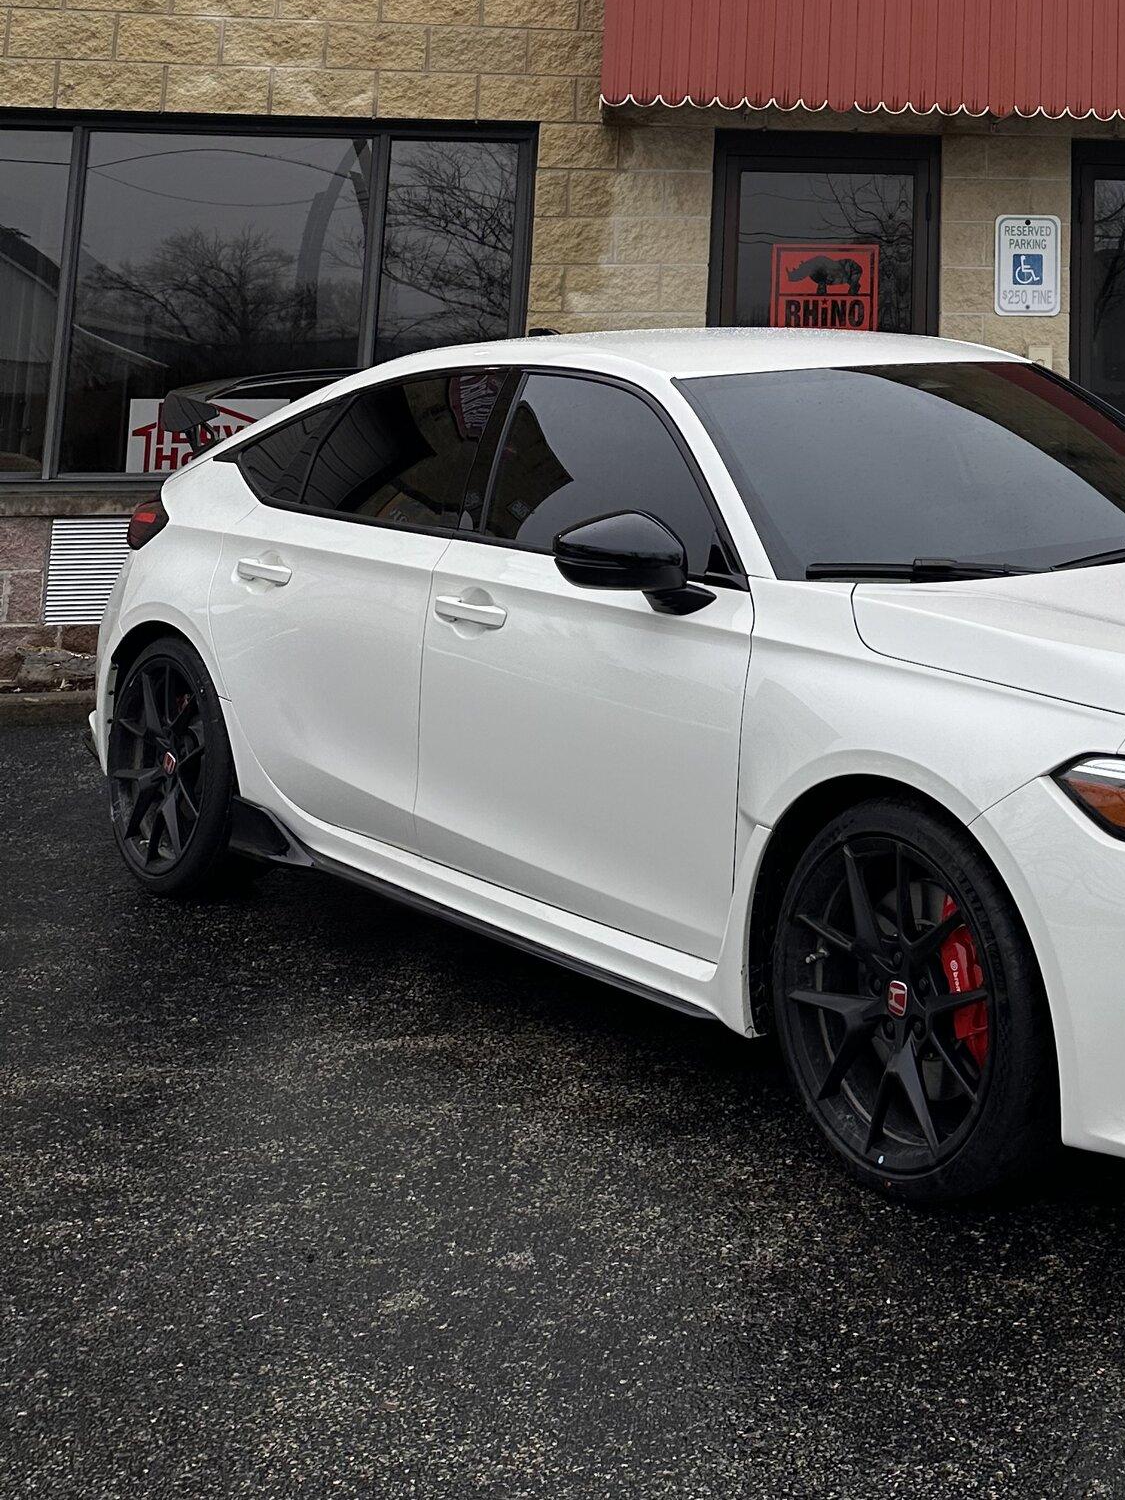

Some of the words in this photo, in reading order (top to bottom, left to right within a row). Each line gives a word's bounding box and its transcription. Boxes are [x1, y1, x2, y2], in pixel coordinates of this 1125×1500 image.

[1004, 225, 1052, 237] RESERVED
[1008, 238, 1047, 250] PARKING
[1002, 290, 1028, 305] $250
[1032, 290, 1053, 305] FINE
